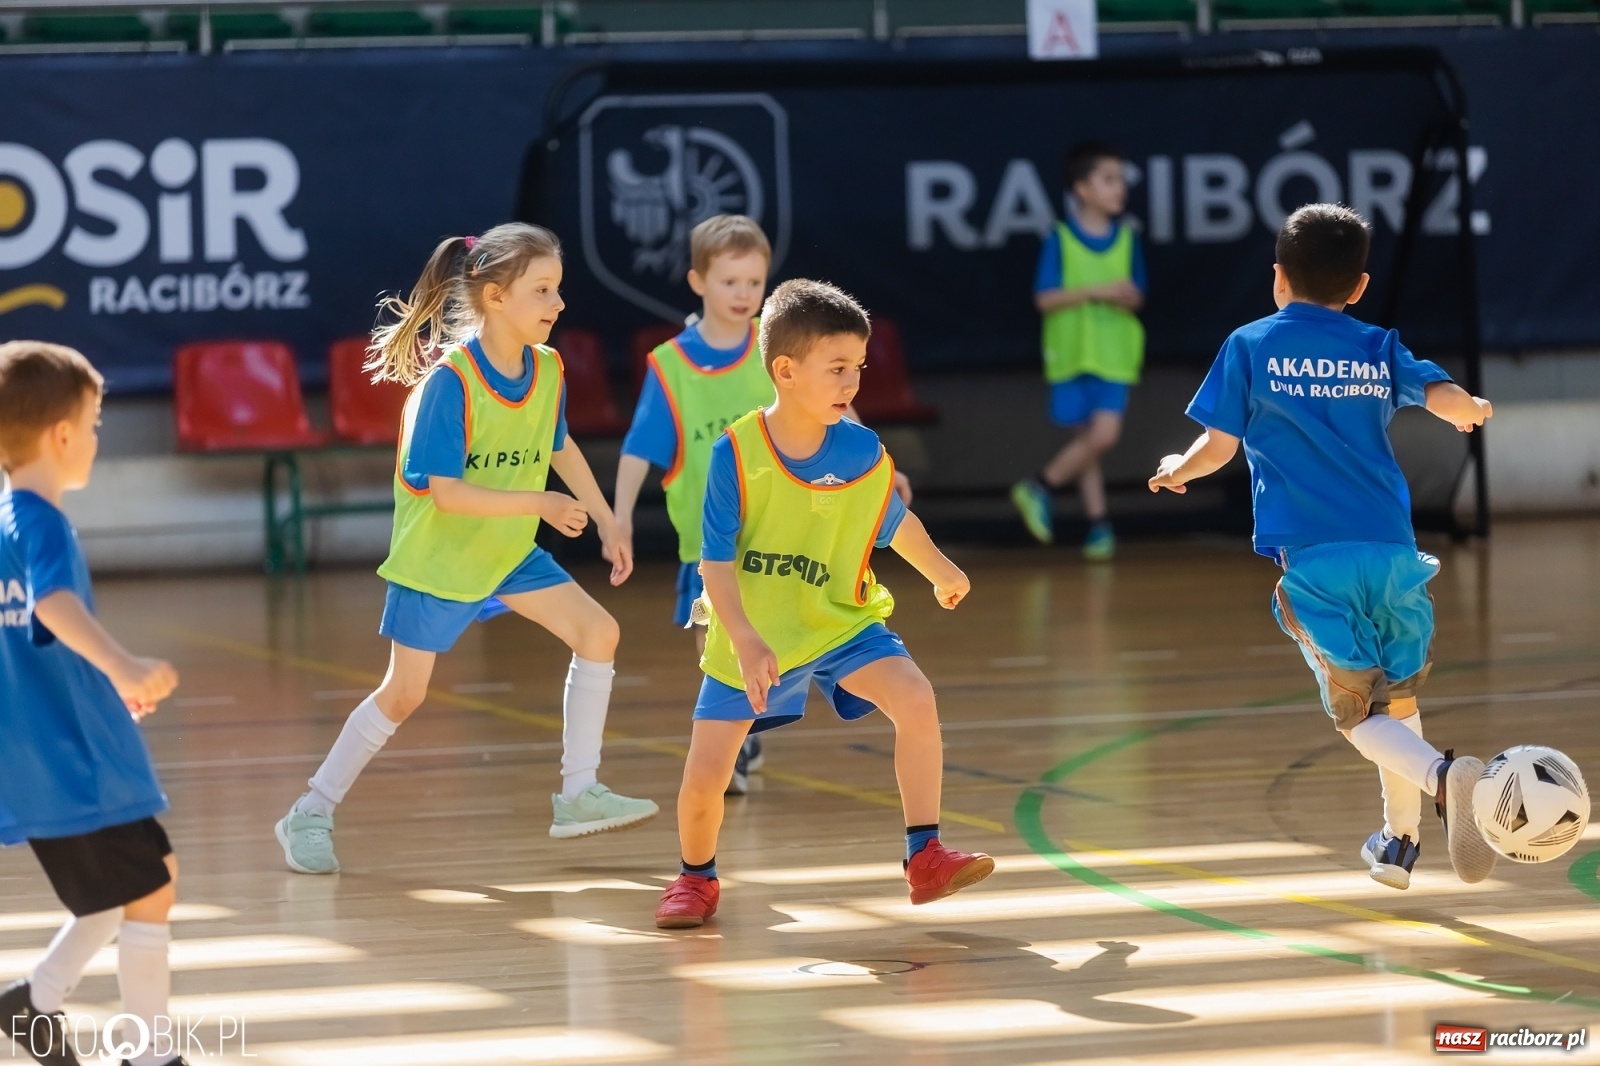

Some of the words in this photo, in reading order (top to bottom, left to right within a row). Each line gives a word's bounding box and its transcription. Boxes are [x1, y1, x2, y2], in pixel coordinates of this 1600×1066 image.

[1041, 9, 1082, 57] A
[89, 262, 309, 314] RACIBÓRZ
[1267, 357, 1390, 380] AKADEMIA
